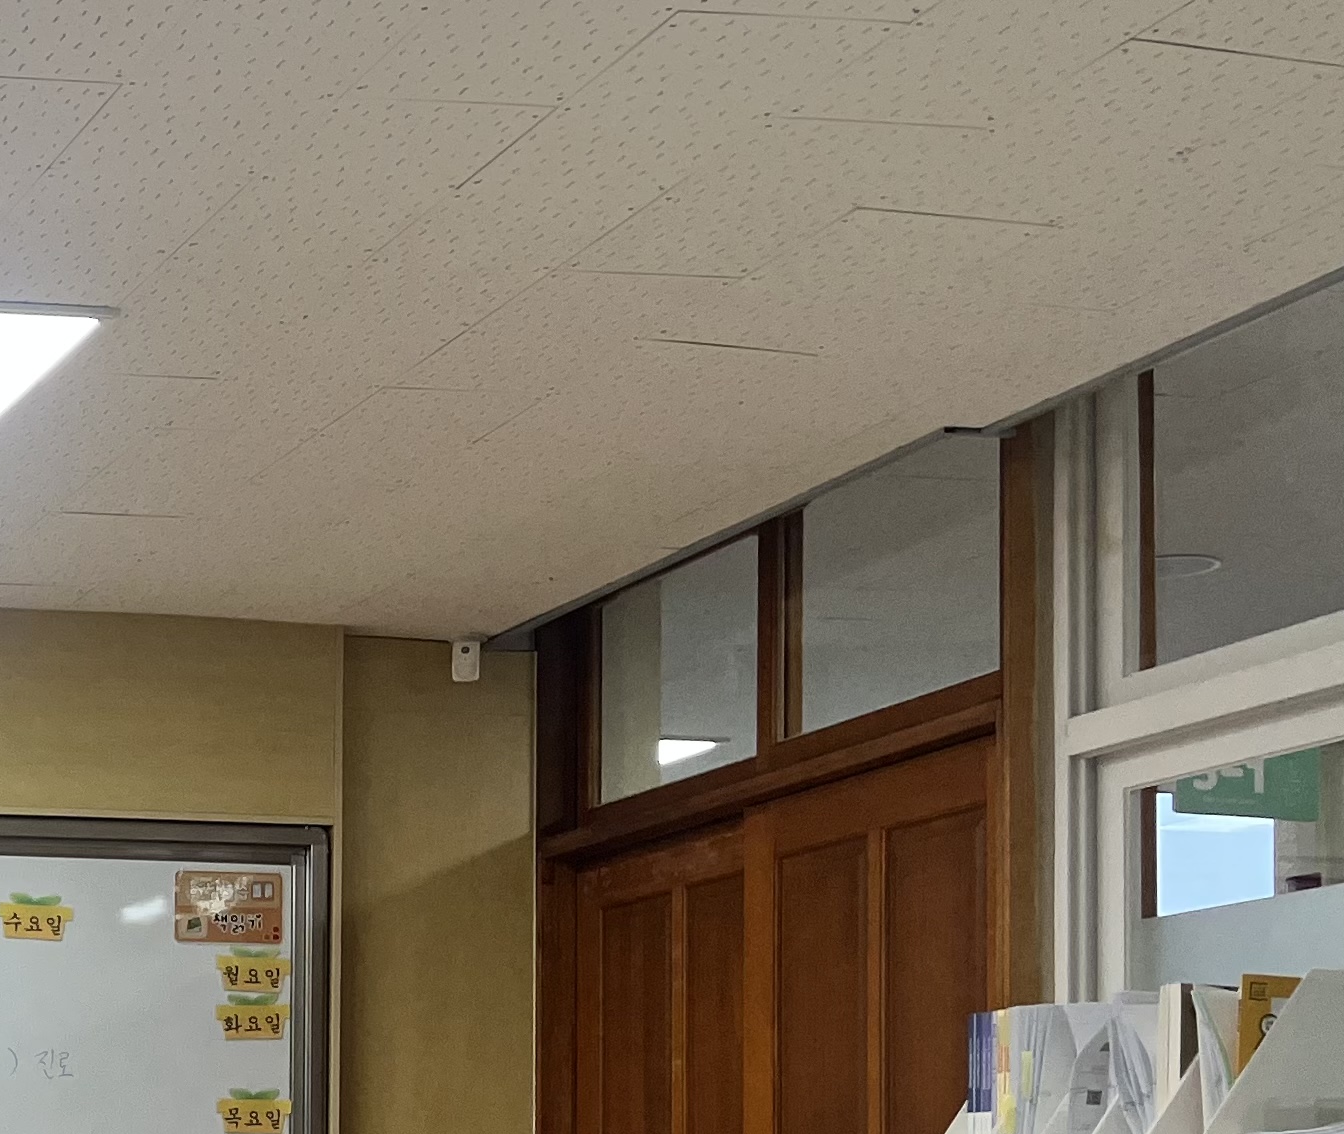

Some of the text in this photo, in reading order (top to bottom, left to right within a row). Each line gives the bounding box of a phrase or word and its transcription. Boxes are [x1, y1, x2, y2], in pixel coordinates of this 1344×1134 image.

[3, 912, 62, 936] 수요일
[213, 913, 263, 934] 책읽기
[223, 965, 280, 989] 월요일
[223, 1013, 281, 1035] 화요일
[34, 1049, 75, 1081] 진로
[224, 1107, 282, 1130] 목요일
